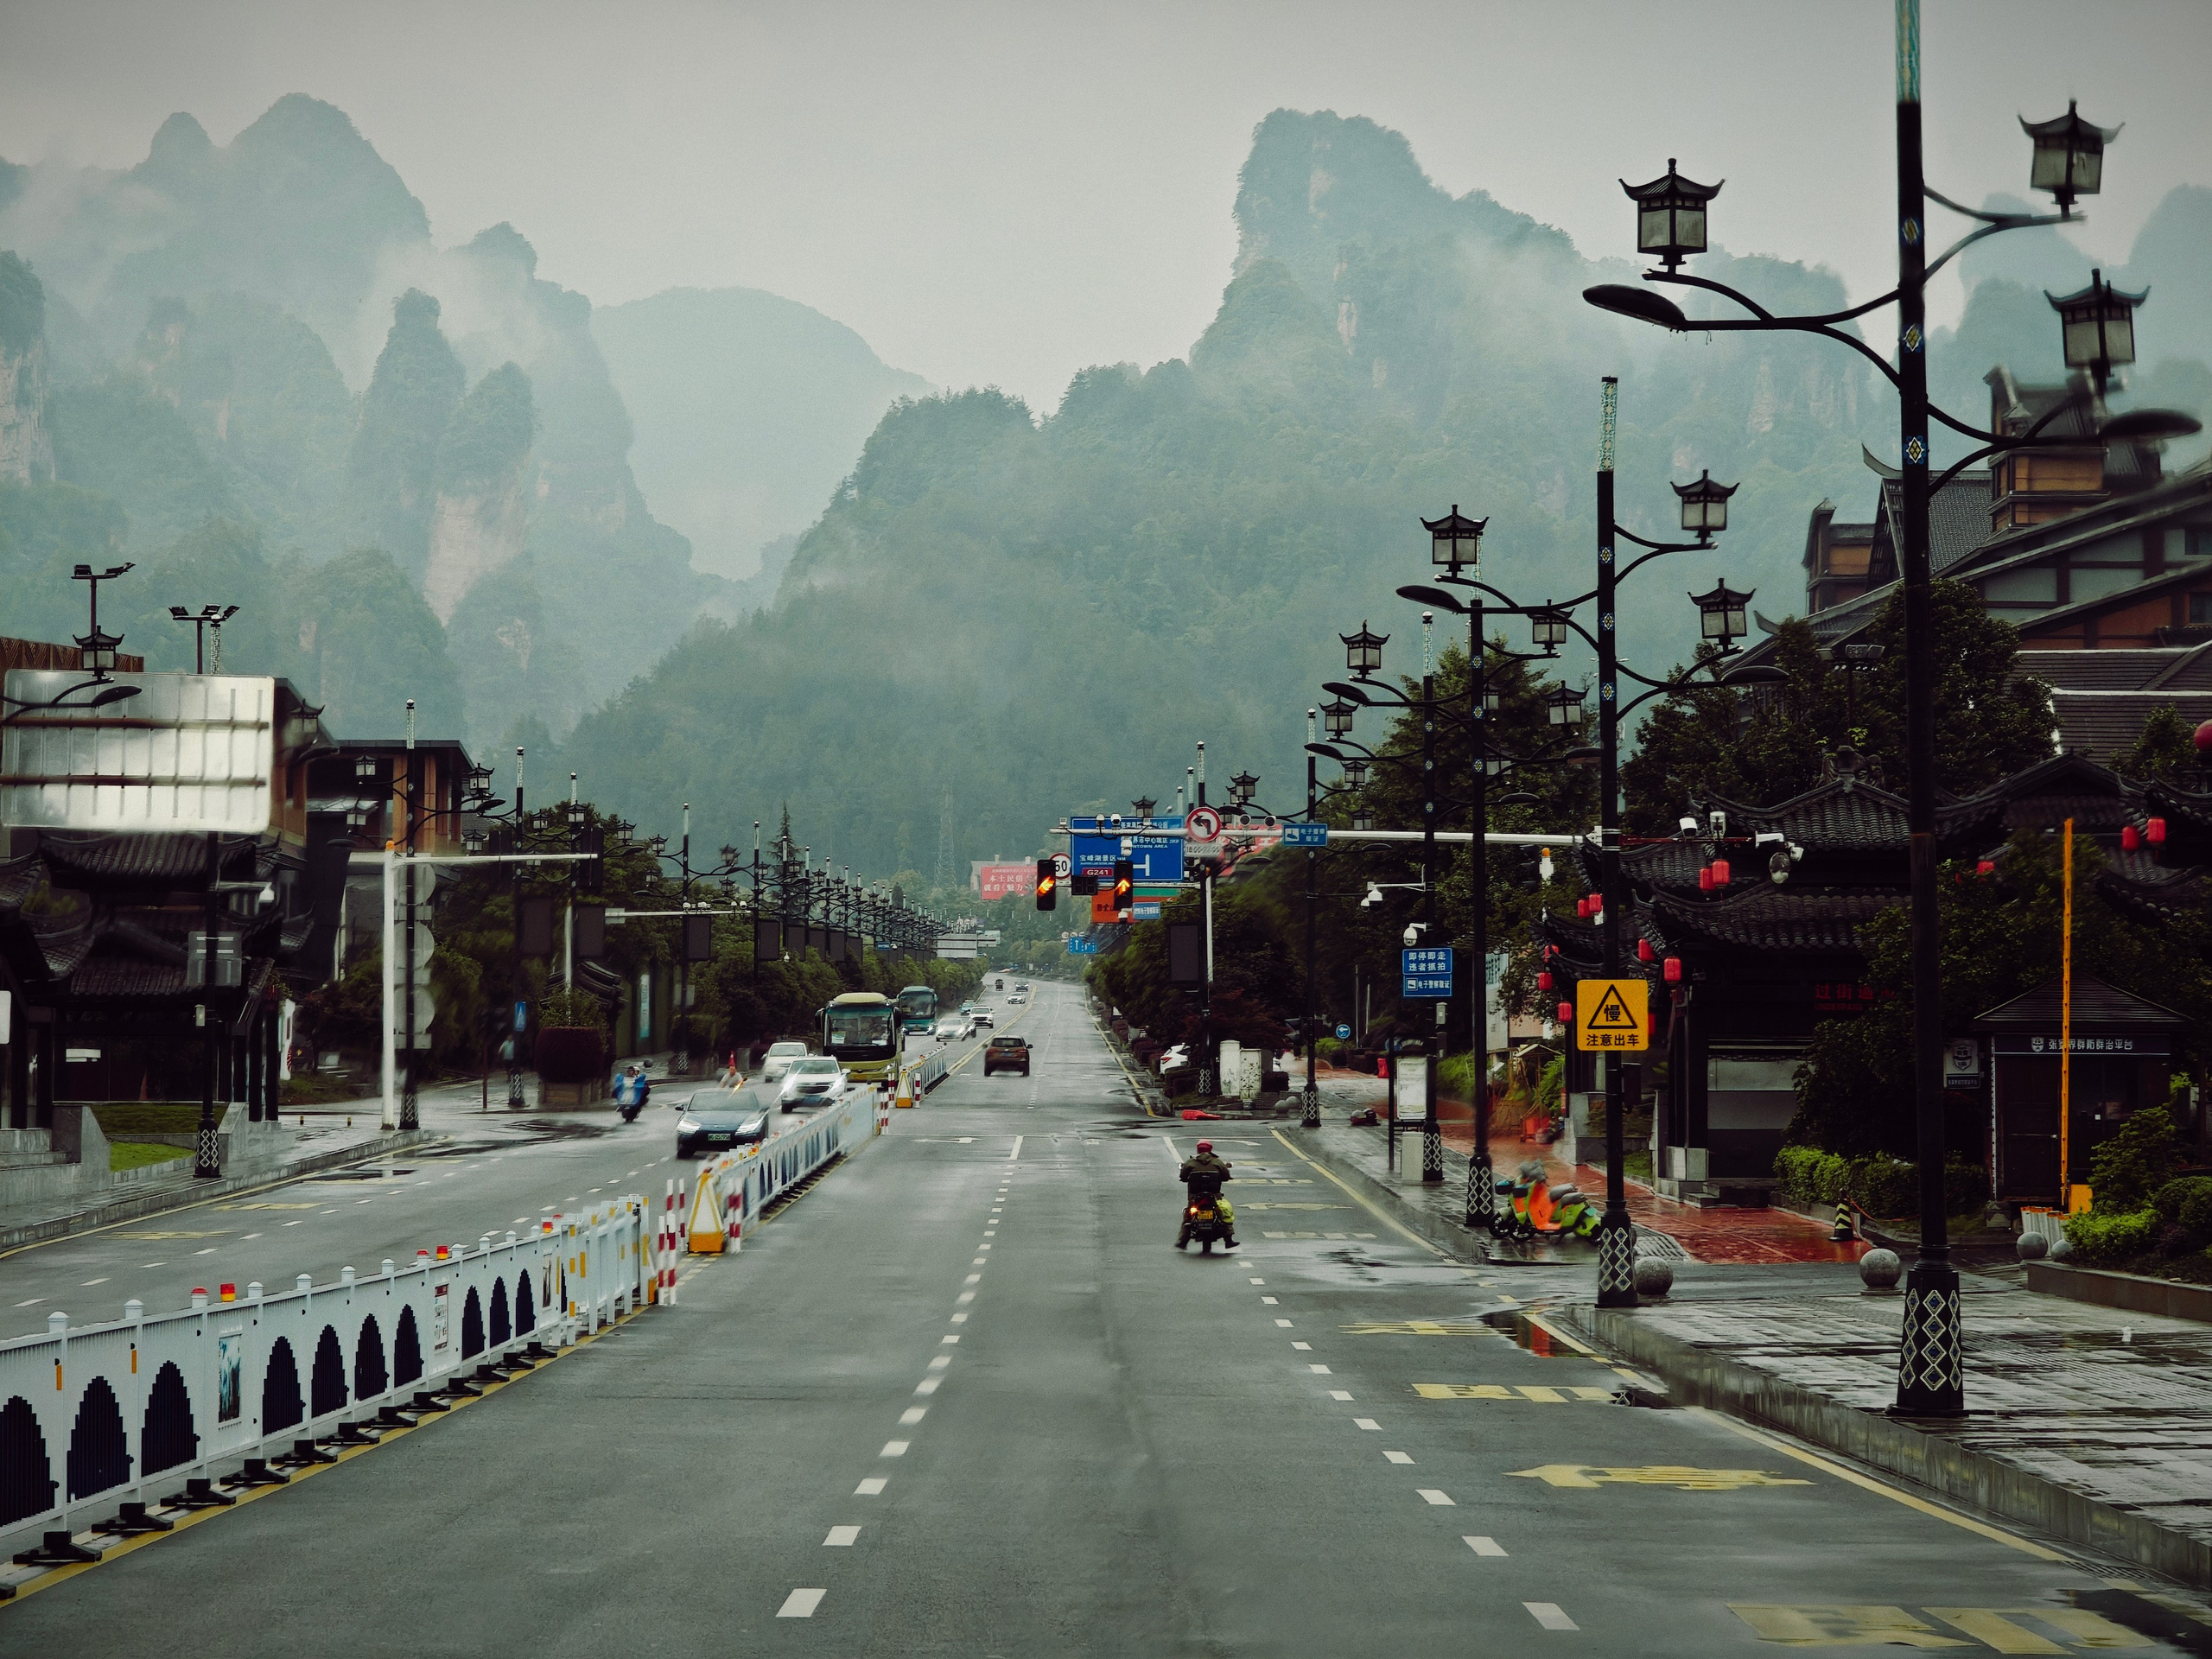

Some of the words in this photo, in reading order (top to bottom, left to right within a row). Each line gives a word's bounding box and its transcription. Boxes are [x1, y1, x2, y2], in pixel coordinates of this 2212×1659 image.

[1408, 951, 1446, 961] 即停即走
[1408, 962, 1446, 971] 违者抓拍
[1418, 980, 1450, 988] 电子警察取证
[1604, 1004, 1621, 1022] 慢
[1586, 1033, 1639, 1046] 注意出车
